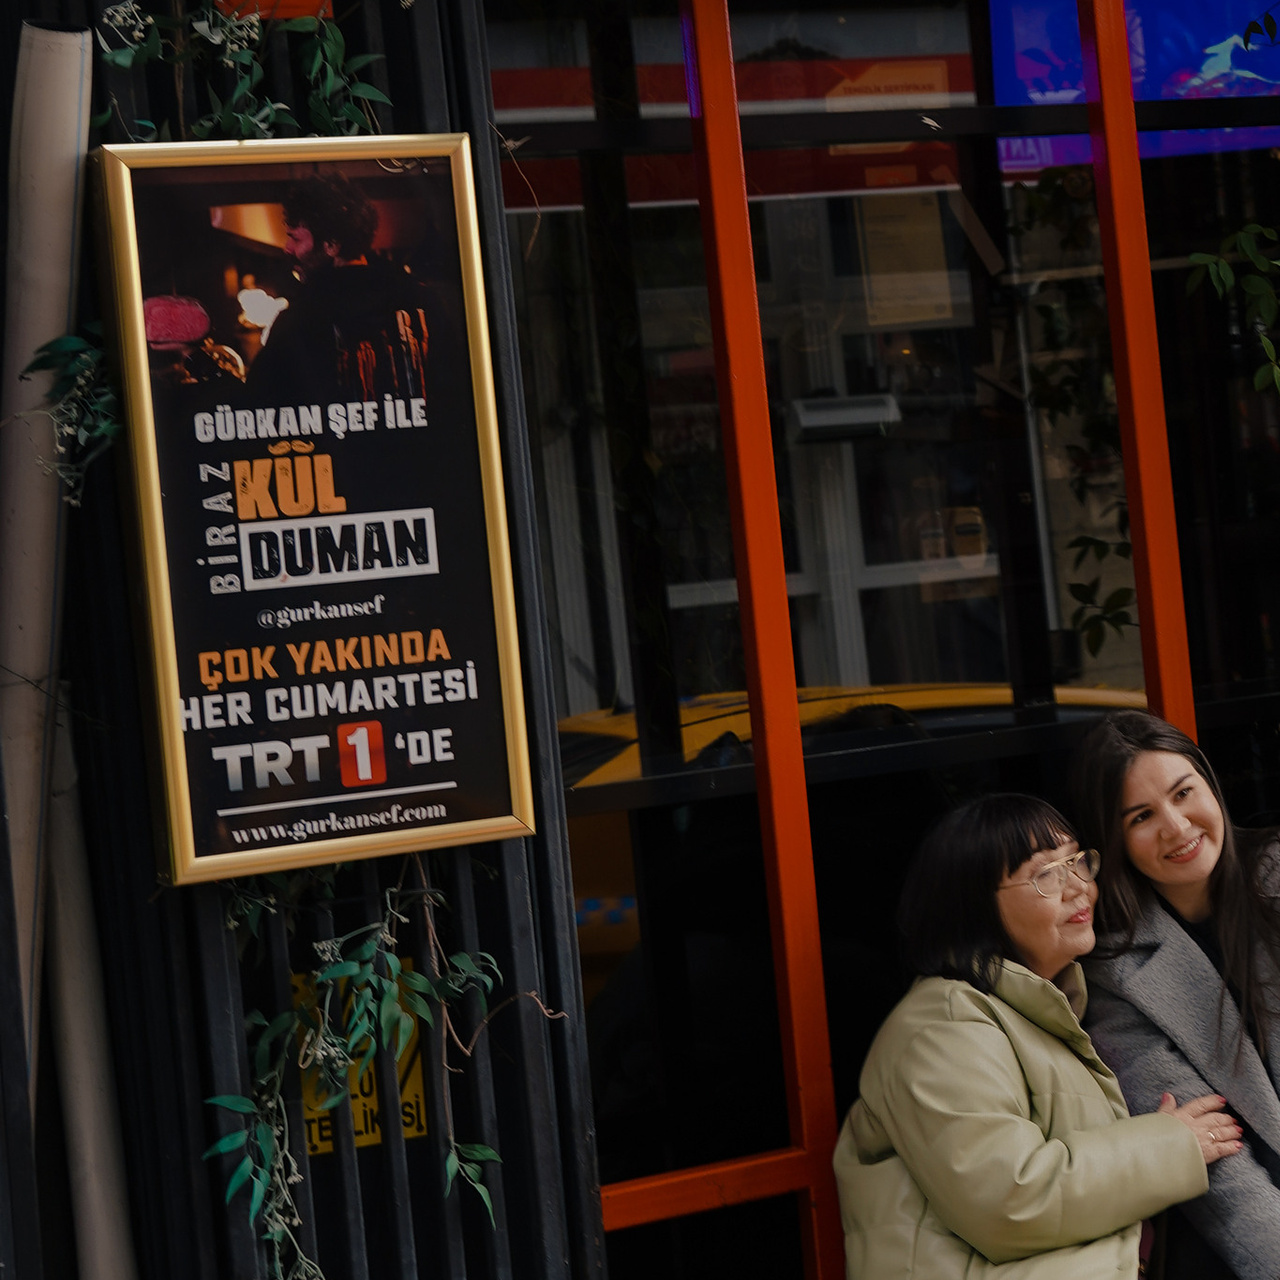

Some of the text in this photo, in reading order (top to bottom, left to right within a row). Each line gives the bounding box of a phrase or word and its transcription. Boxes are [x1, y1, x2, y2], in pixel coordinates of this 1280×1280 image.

[194, 393, 428, 444] GÜRKAN ŞEF İLE
[233, 440, 347, 521] KÜL
[196, 461, 242, 595] BİRAZ
[248, 517, 431, 581] DUMAN
[256, 594, 386, 629] @gurkansef
[198, 628, 452, 692] ÇOK YAKINDA
[179, 660, 479, 732] HER CUMARTESİ
[211, 733, 331, 792] TRT
[231, 801, 447, 845] www.gurkansef.com
